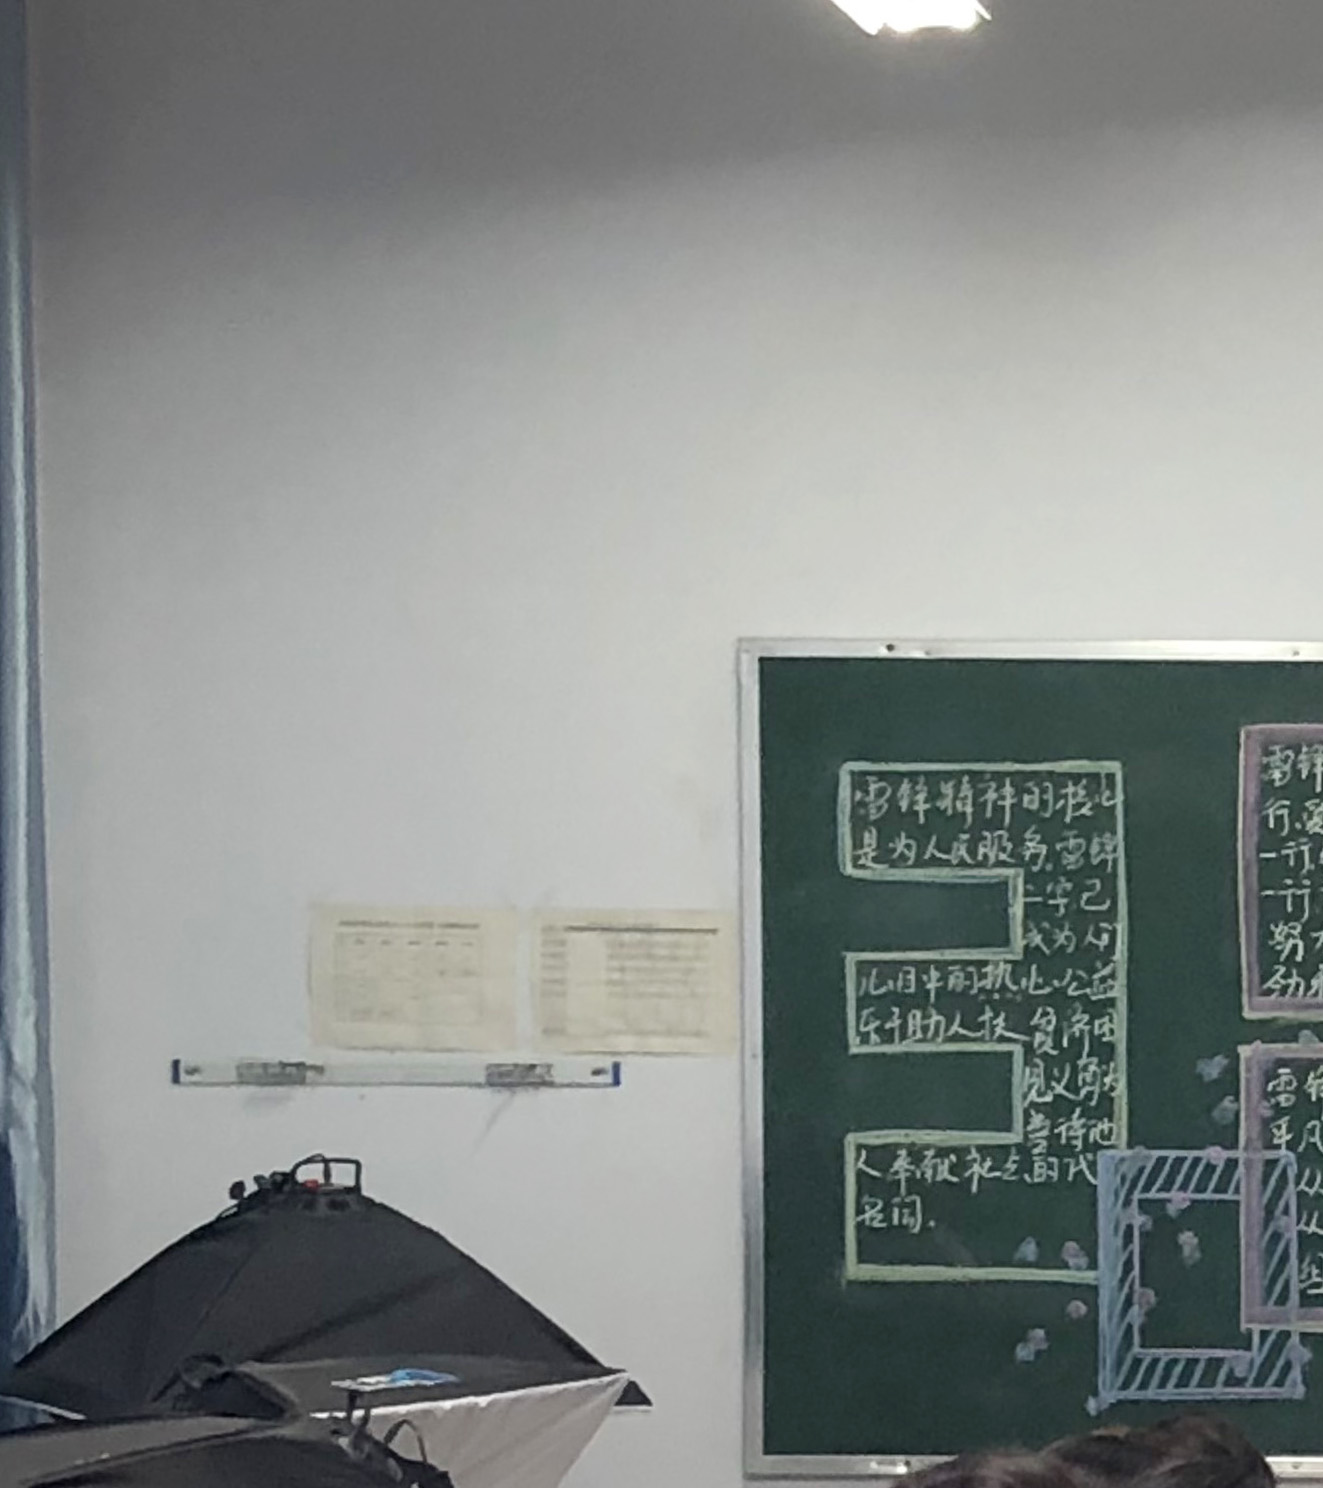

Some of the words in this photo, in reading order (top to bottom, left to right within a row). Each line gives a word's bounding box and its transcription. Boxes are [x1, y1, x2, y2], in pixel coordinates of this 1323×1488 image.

[854, 774, 1123, 829] 雷锋精神的核心
